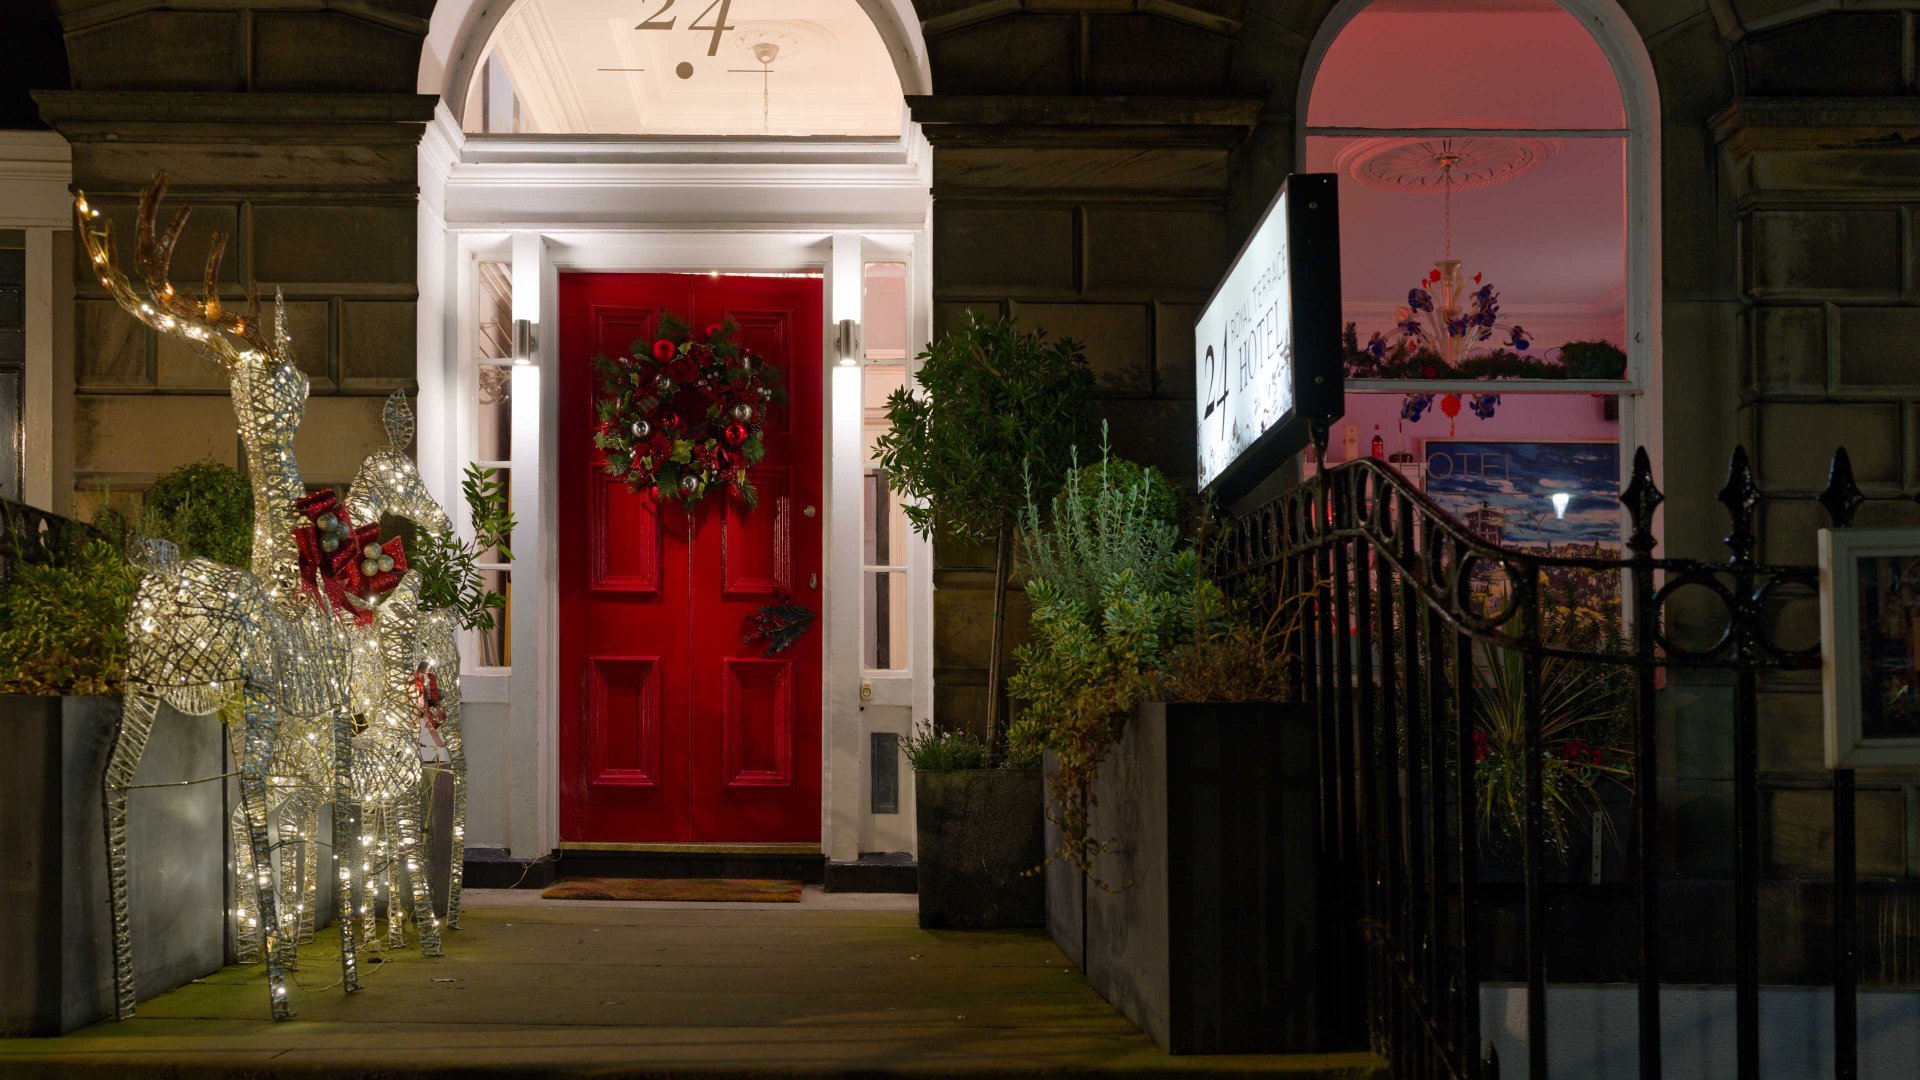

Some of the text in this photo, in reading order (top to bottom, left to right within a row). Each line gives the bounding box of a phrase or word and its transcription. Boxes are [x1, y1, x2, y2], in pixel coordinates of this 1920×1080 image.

[635, 0, 735, 56] 24
[1230, 244, 1286, 345] ROYAL TERRACE
[1203, 320, 1229, 442] 24
[1238, 299, 1283, 394] HOTEL
[1400, 452, 1524, 480] HOTEL
